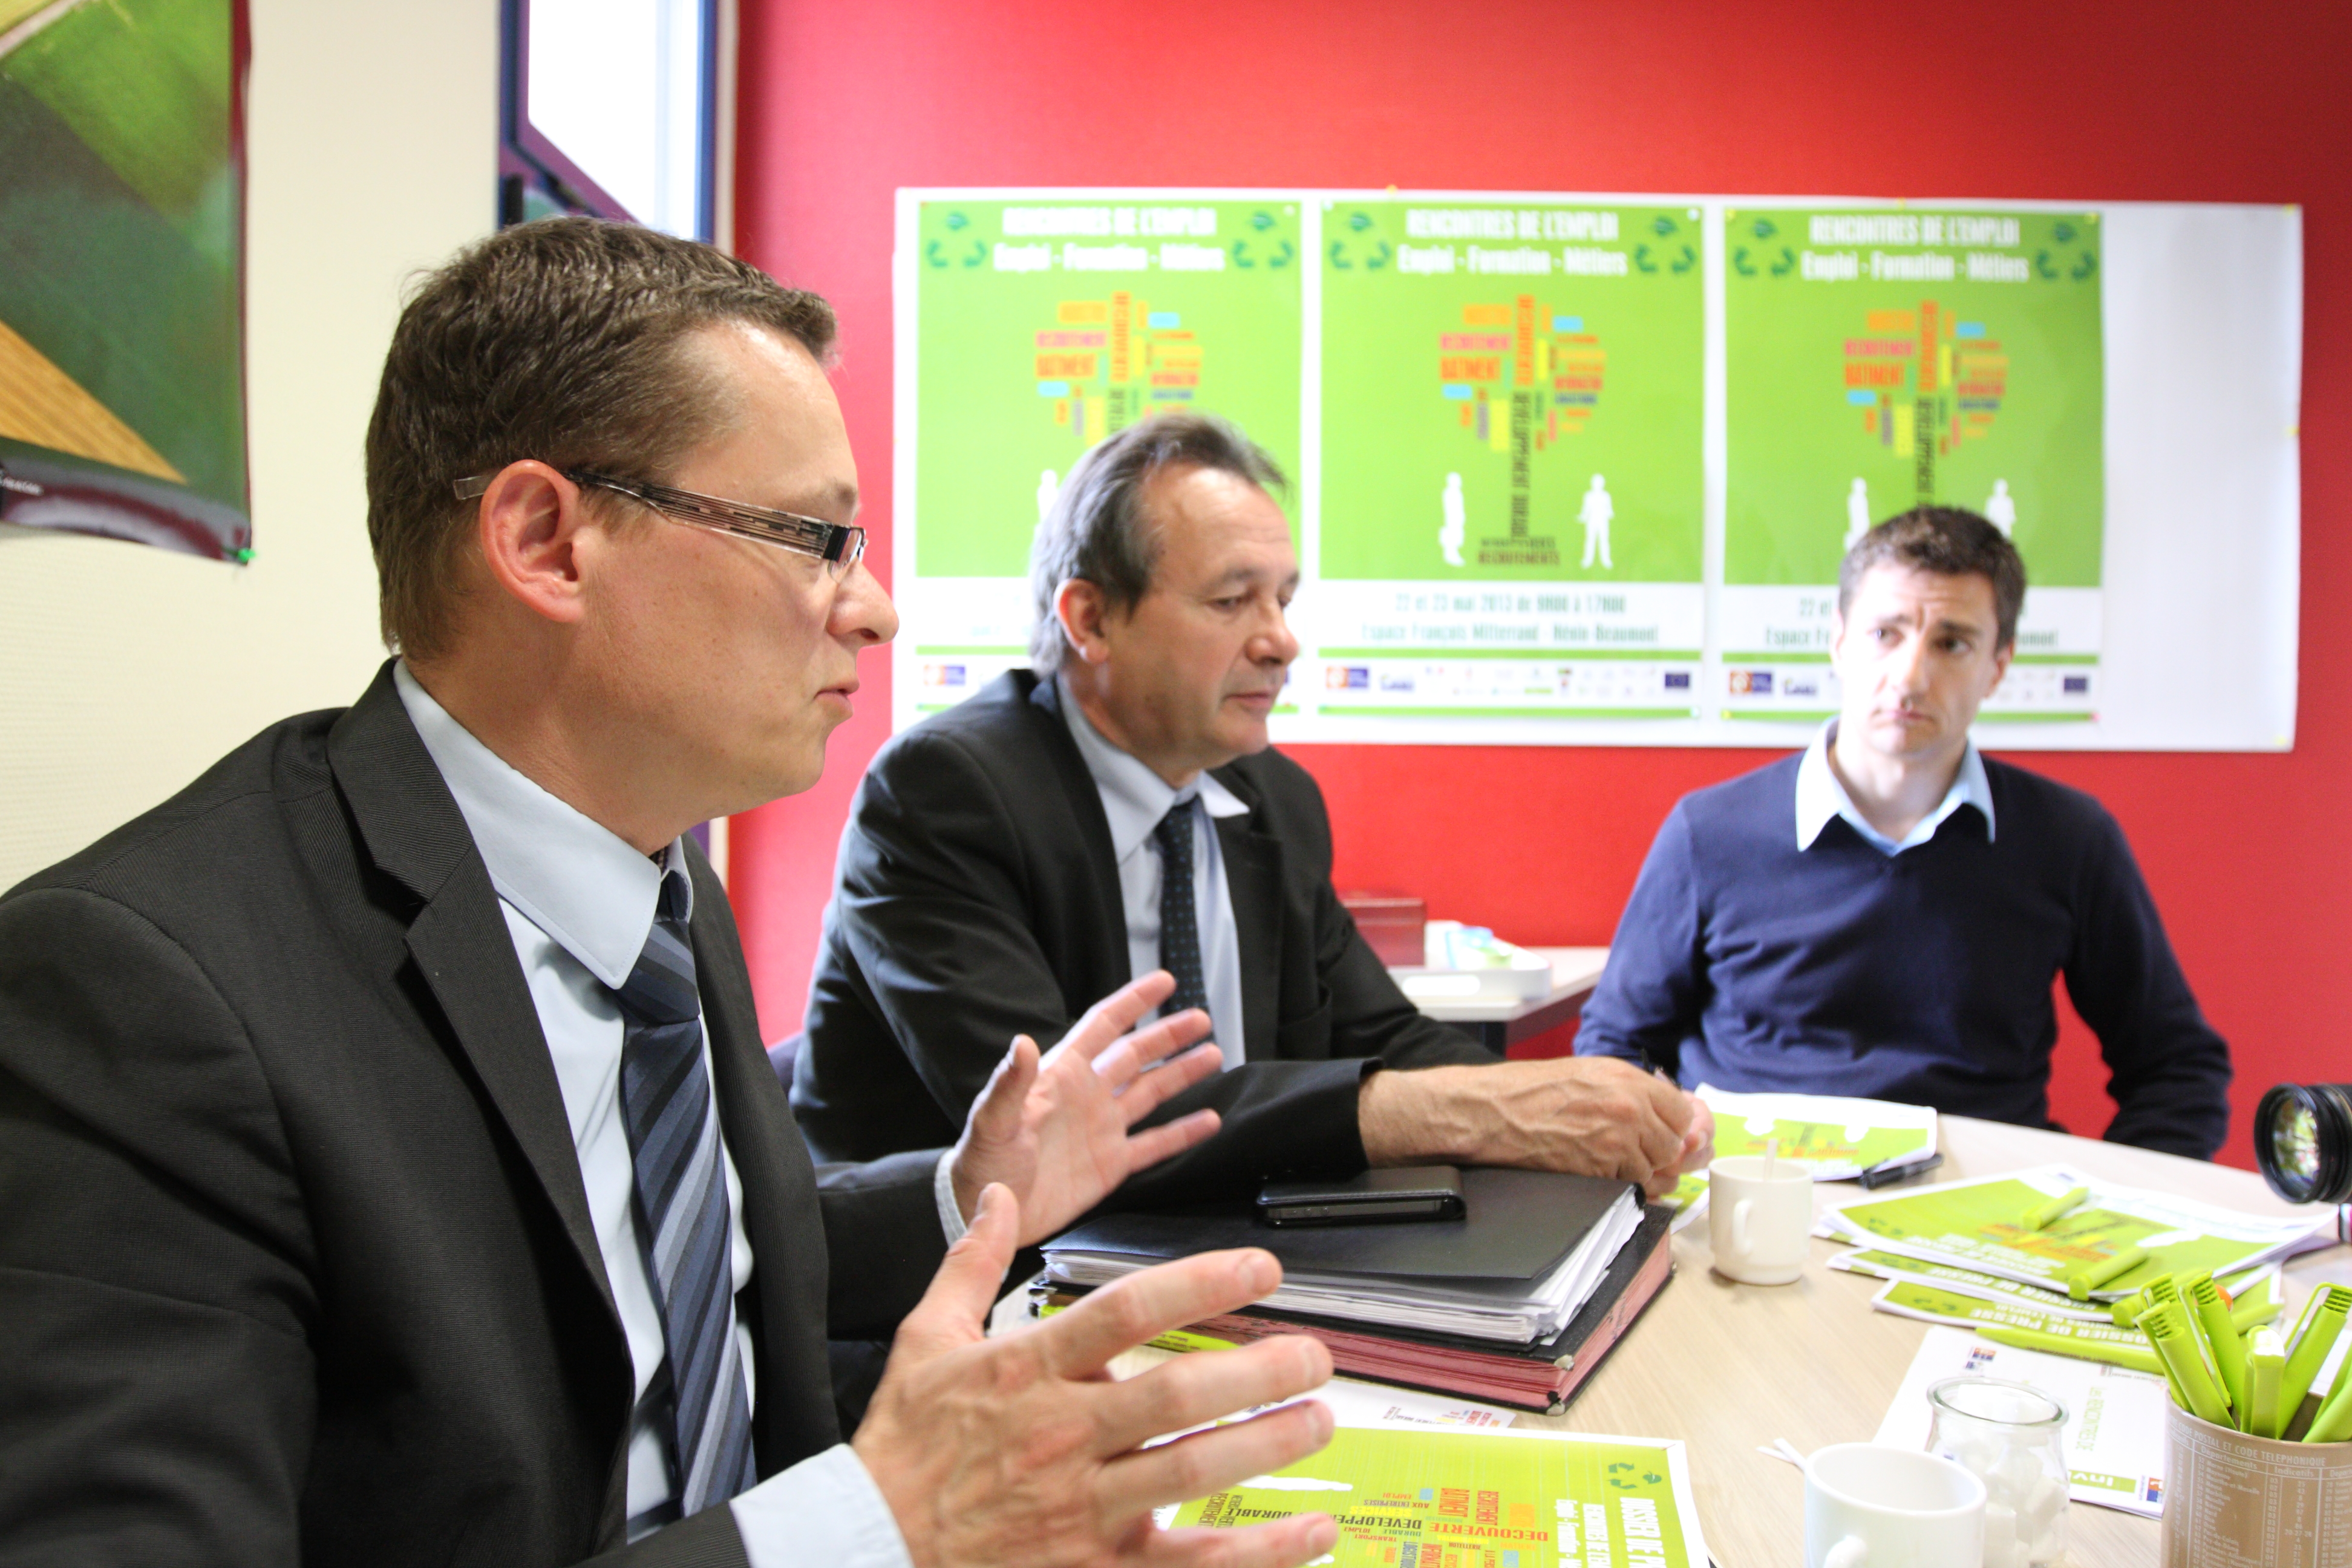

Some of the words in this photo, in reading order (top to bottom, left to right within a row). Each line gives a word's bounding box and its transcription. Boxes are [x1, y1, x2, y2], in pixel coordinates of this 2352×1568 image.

[1406, 209, 1515, 239] RENCONTRES
[1517, 211, 1541, 240] DE
[1544, 212, 1619, 241] L'EMPLOI
[1809, 215, 1918, 245] RENCONTRES
[1921, 216, 1945, 246] DE
[1949, 217, 2020, 247] L'EMPLOI
[1397, 244, 1455, 275] Emploi
[1468, 245, 1552, 275] Formation
[1563, 246, 1628, 276] Métiers
[1801, 250, 1858, 282] Emploi
[1870, 250, 1955, 281] Formation
[1966, 252, 2030, 283] Métiers
[1766, 626, 1811, 650] Espace
[1968, 1308, 2043, 1330] PRESSE
[2046, 1323, 2073, 1336] DE
[2076, 1327, 2148, 1345] OSSIER
[2178, 1422, 2192, 1437] CODE
[2194, 1429, 2220, 1448] POSTAL
[2223, 1442, 2233, 1451] ET
[2235, 1445, 2258, 1459] CODE
[1223, 1507, 1292, 1521] DURABLE
[1310, 1512, 1422, 1530] DEVELOPPE
[1348, 1504, 1413, 1518] SERVICES
[1619, 1497, 1661, 1538] DOSSIER
[1354, 1533, 1397, 1543] TRANSPORT
[1382, 1527, 1422, 1538] DURABLE
[1428, 1522, 1549, 1542] DECOUVERTE
[1625, 1537, 1665, 1555] DE
